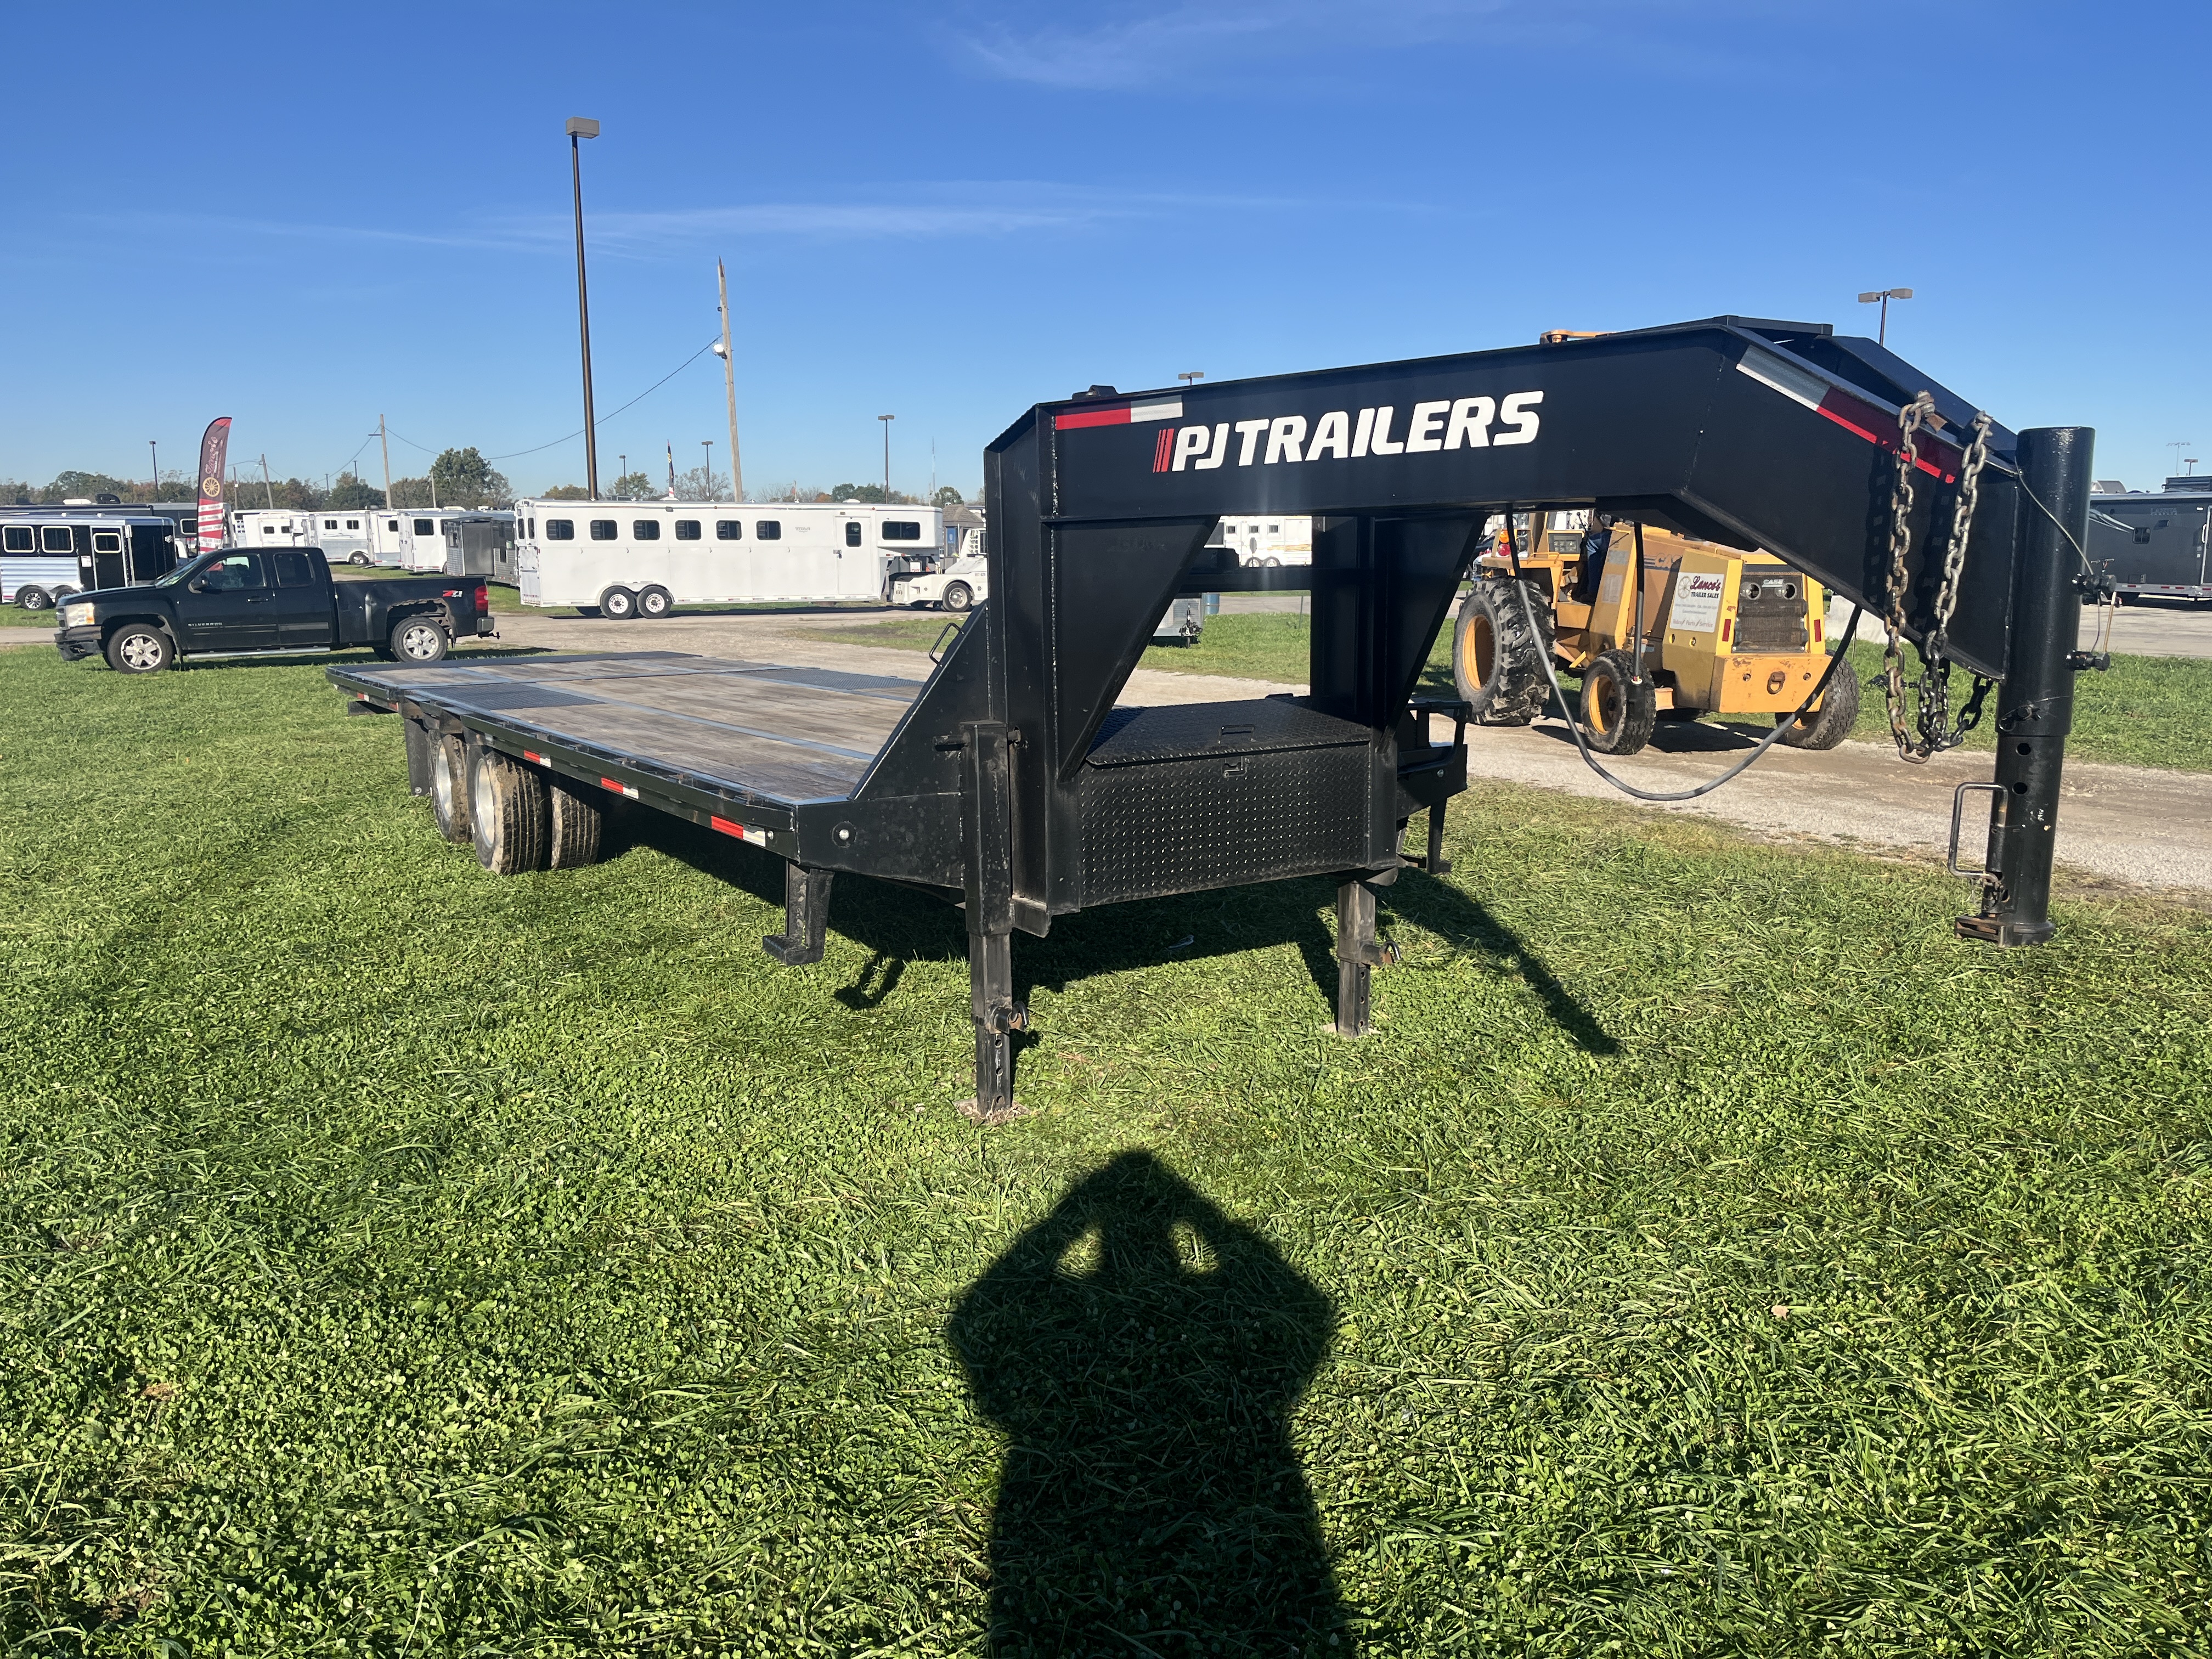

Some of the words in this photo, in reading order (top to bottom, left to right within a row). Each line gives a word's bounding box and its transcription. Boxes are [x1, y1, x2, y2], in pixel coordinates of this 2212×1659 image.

[1171, 423, 1229, 472] PJ
[1235, 390, 1544, 467] TRAILERS
[1690, 575, 1721, 591] Lanco's
